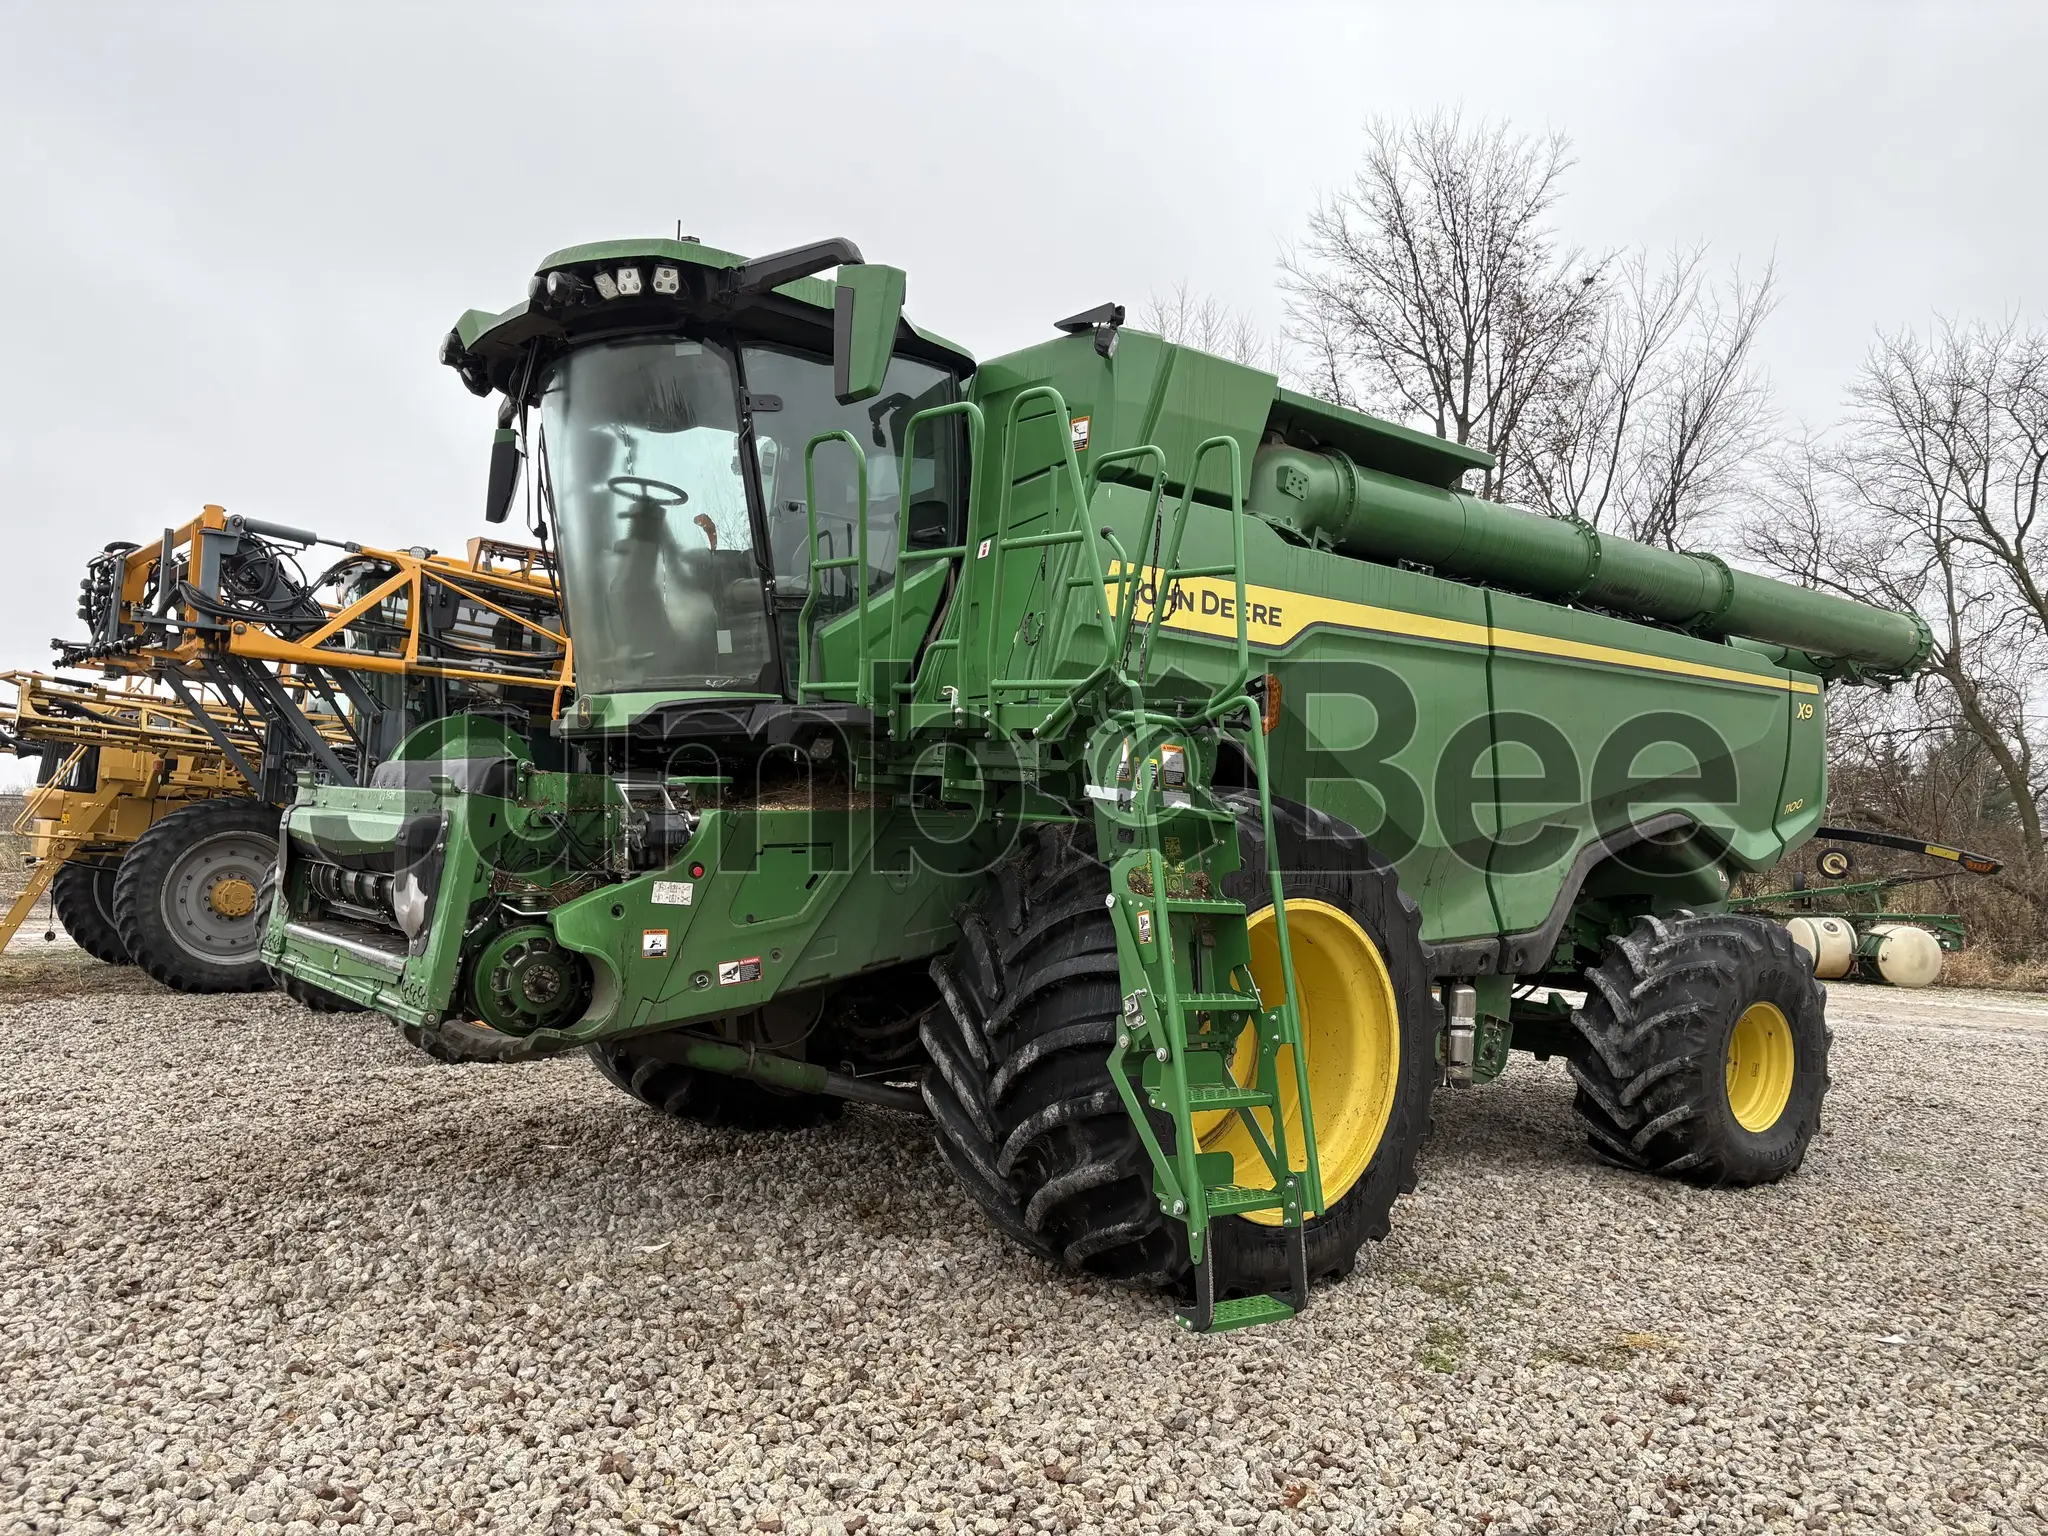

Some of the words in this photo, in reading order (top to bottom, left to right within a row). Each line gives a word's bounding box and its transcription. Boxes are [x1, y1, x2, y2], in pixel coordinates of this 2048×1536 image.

[1125, 581, 1195, 613] OHN
[1796, 701, 1813, 720] X9
[1784, 798, 1803, 815] 1100
